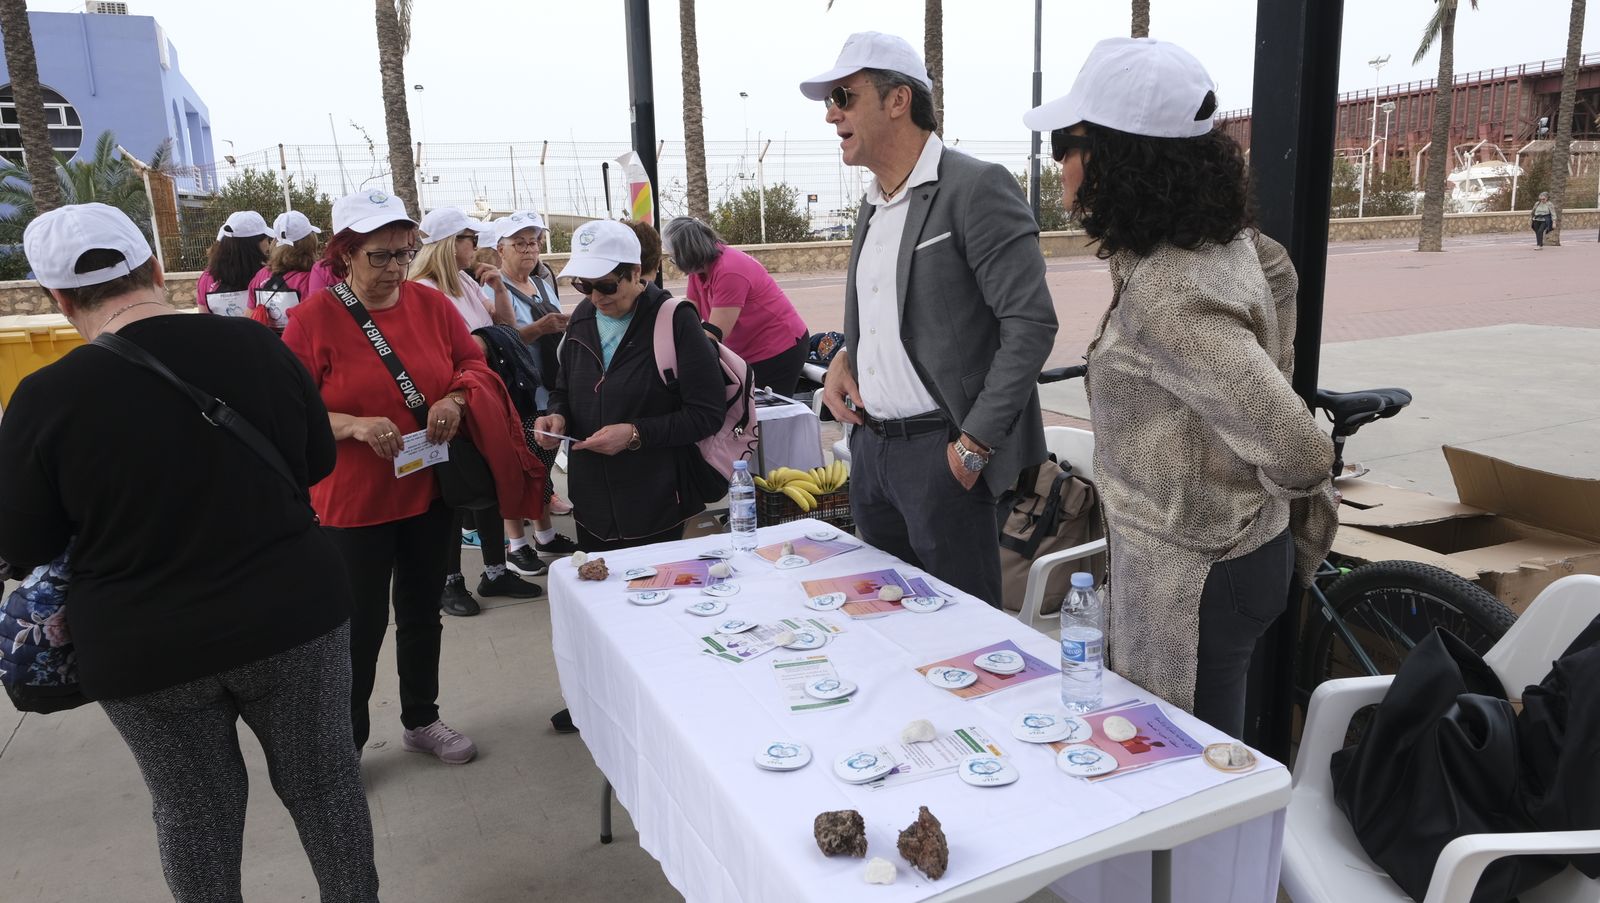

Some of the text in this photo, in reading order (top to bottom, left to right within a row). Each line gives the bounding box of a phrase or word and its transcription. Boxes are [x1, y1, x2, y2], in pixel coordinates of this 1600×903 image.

[334, 282, 358, 307] BIMB
[362, 320, 392, 357] BIMBA
[396, 371, 424, 408] BIMBA
